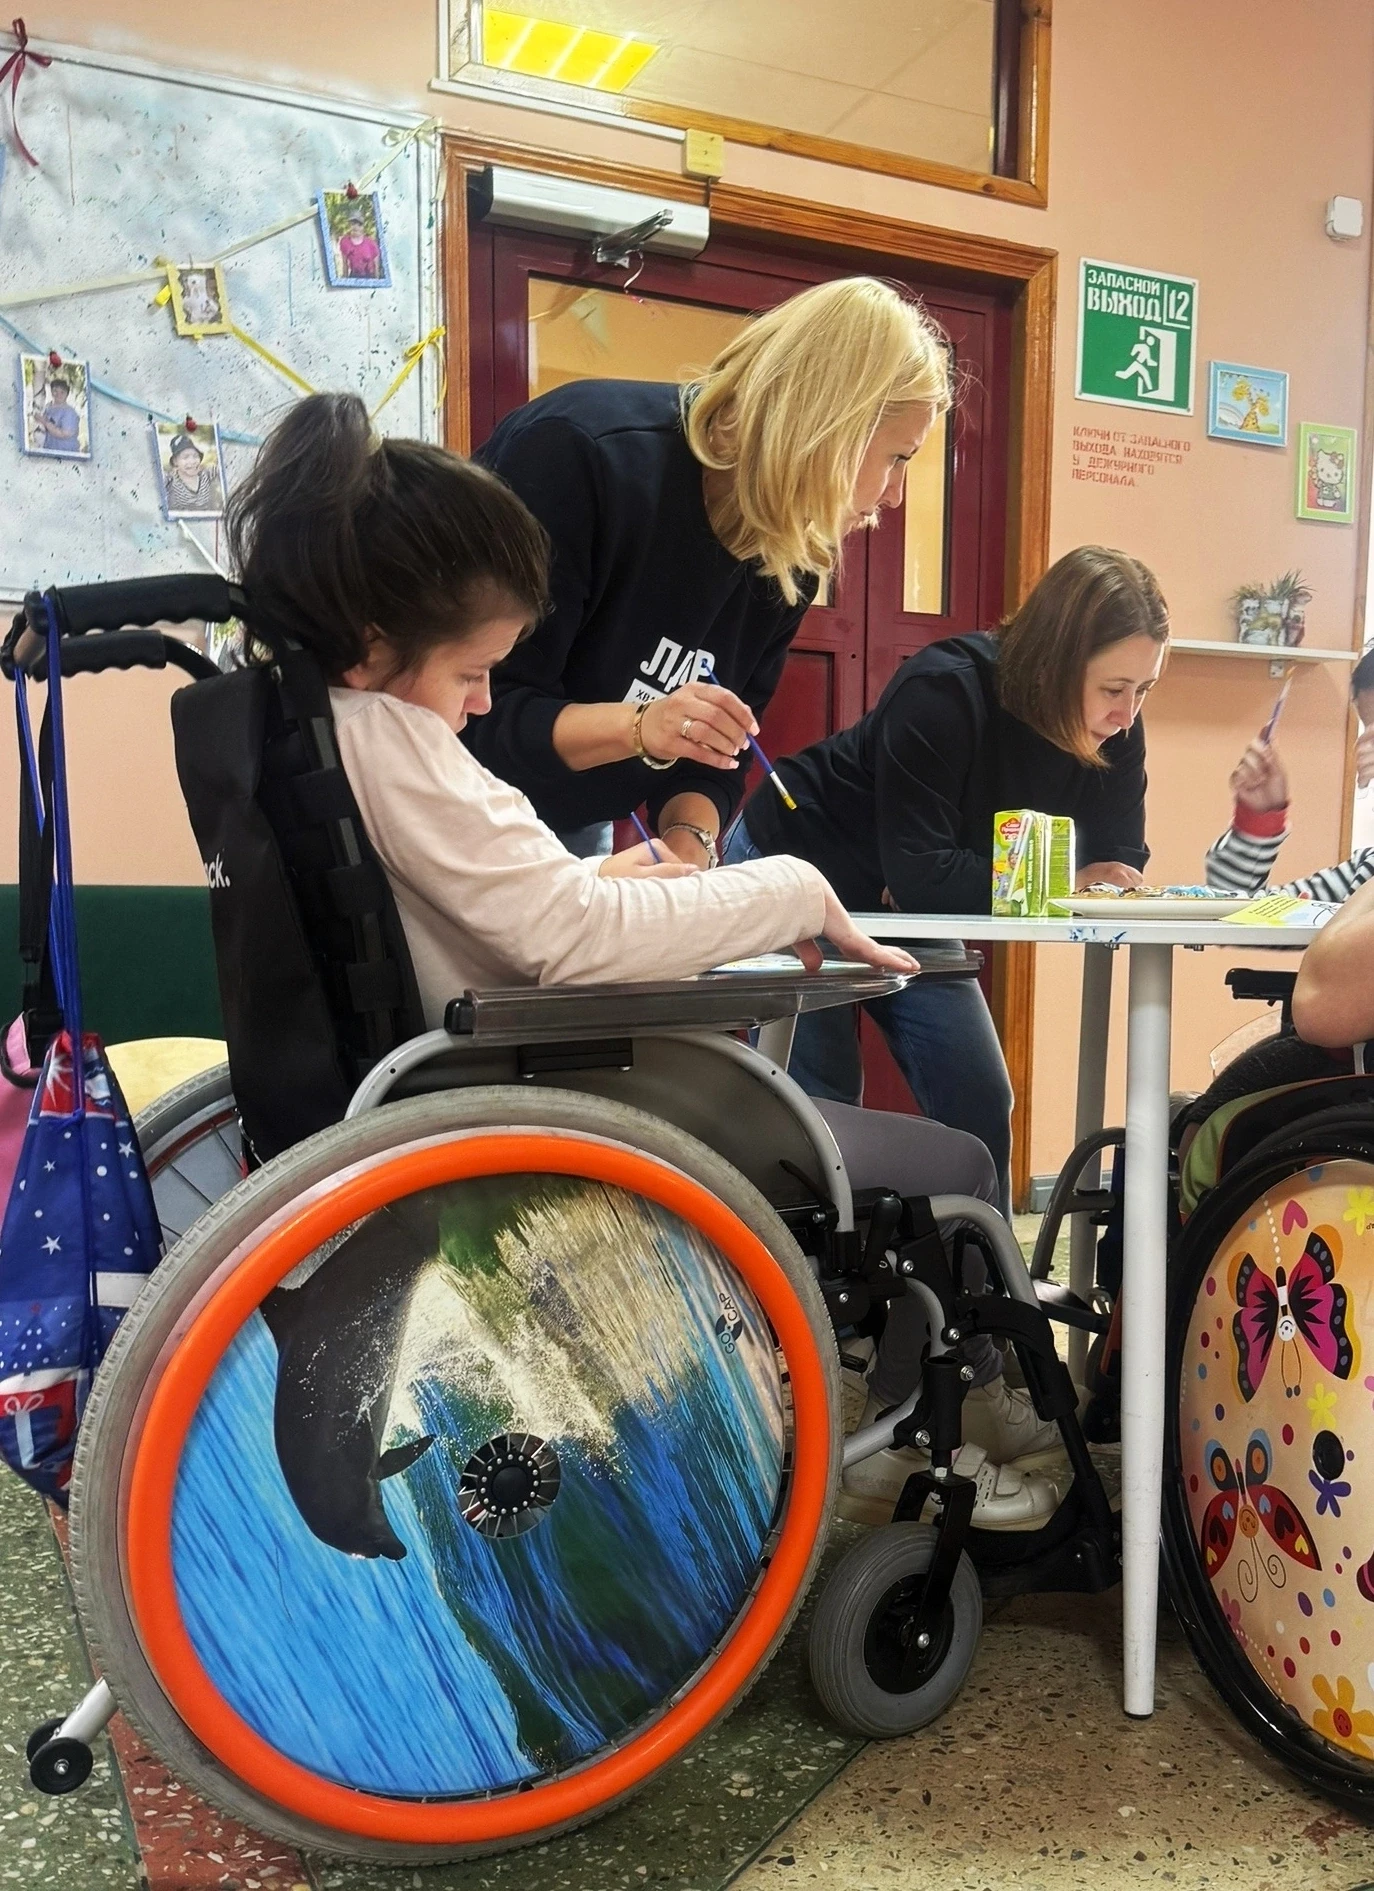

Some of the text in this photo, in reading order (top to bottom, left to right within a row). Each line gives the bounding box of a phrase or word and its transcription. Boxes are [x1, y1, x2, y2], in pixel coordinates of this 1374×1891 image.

[1087, 269, 1161, 296] ЗАПАСНОЙ
[1087, 286, 1162, 323] ВЫХОД
[1168, 289, 1190, 322] 12
[1072, 426, 1191, 452] КЛЮЧИ ОТ ЗАПАСНОГО
[1072, 440, 1182, 464] ВЫХОДА НАХОДЯТСЯ
[1072, 454, 1155, 475] У ДЕЖУРНОГО
[718, 1292, 738, 1355] GO CAP
